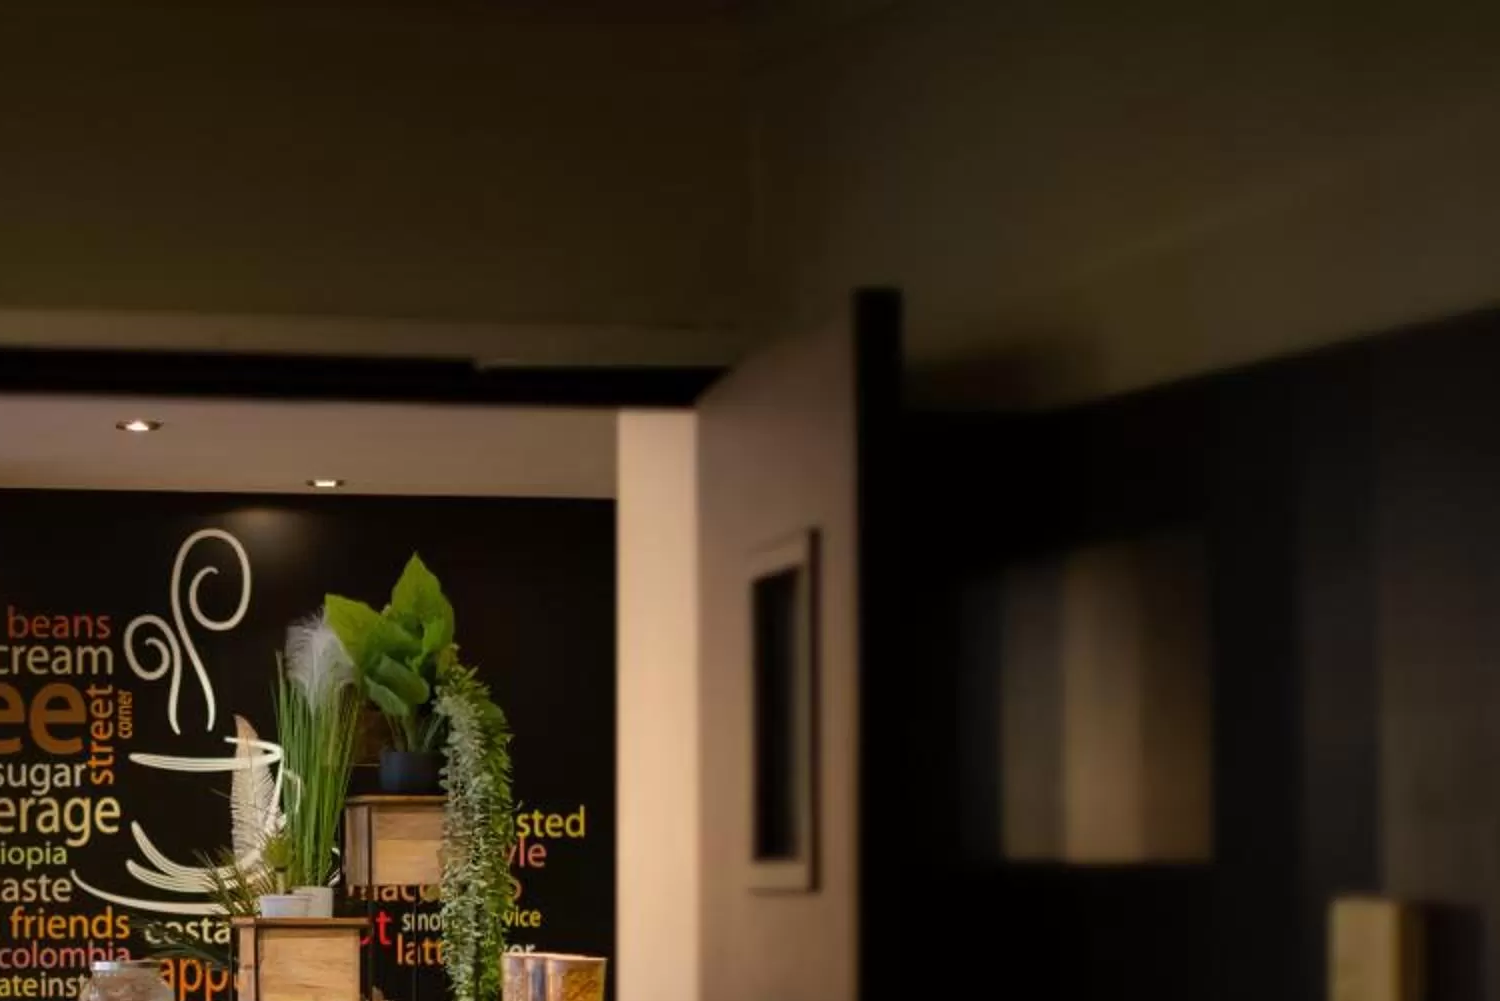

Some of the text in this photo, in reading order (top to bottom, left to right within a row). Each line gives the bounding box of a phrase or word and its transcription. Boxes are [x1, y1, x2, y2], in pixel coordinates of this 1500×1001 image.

[7, 604, 111, 640] beans
[117, 690, 133, 739] corner
[86, 684, 114, 785] street
[515, 804, 586, 839] sted
[10, 906, 130, 941] friends
[503, 904, 542, 929] vice
[396, 932, 444, 966] latt
[39, 971, 88, 998] inst
